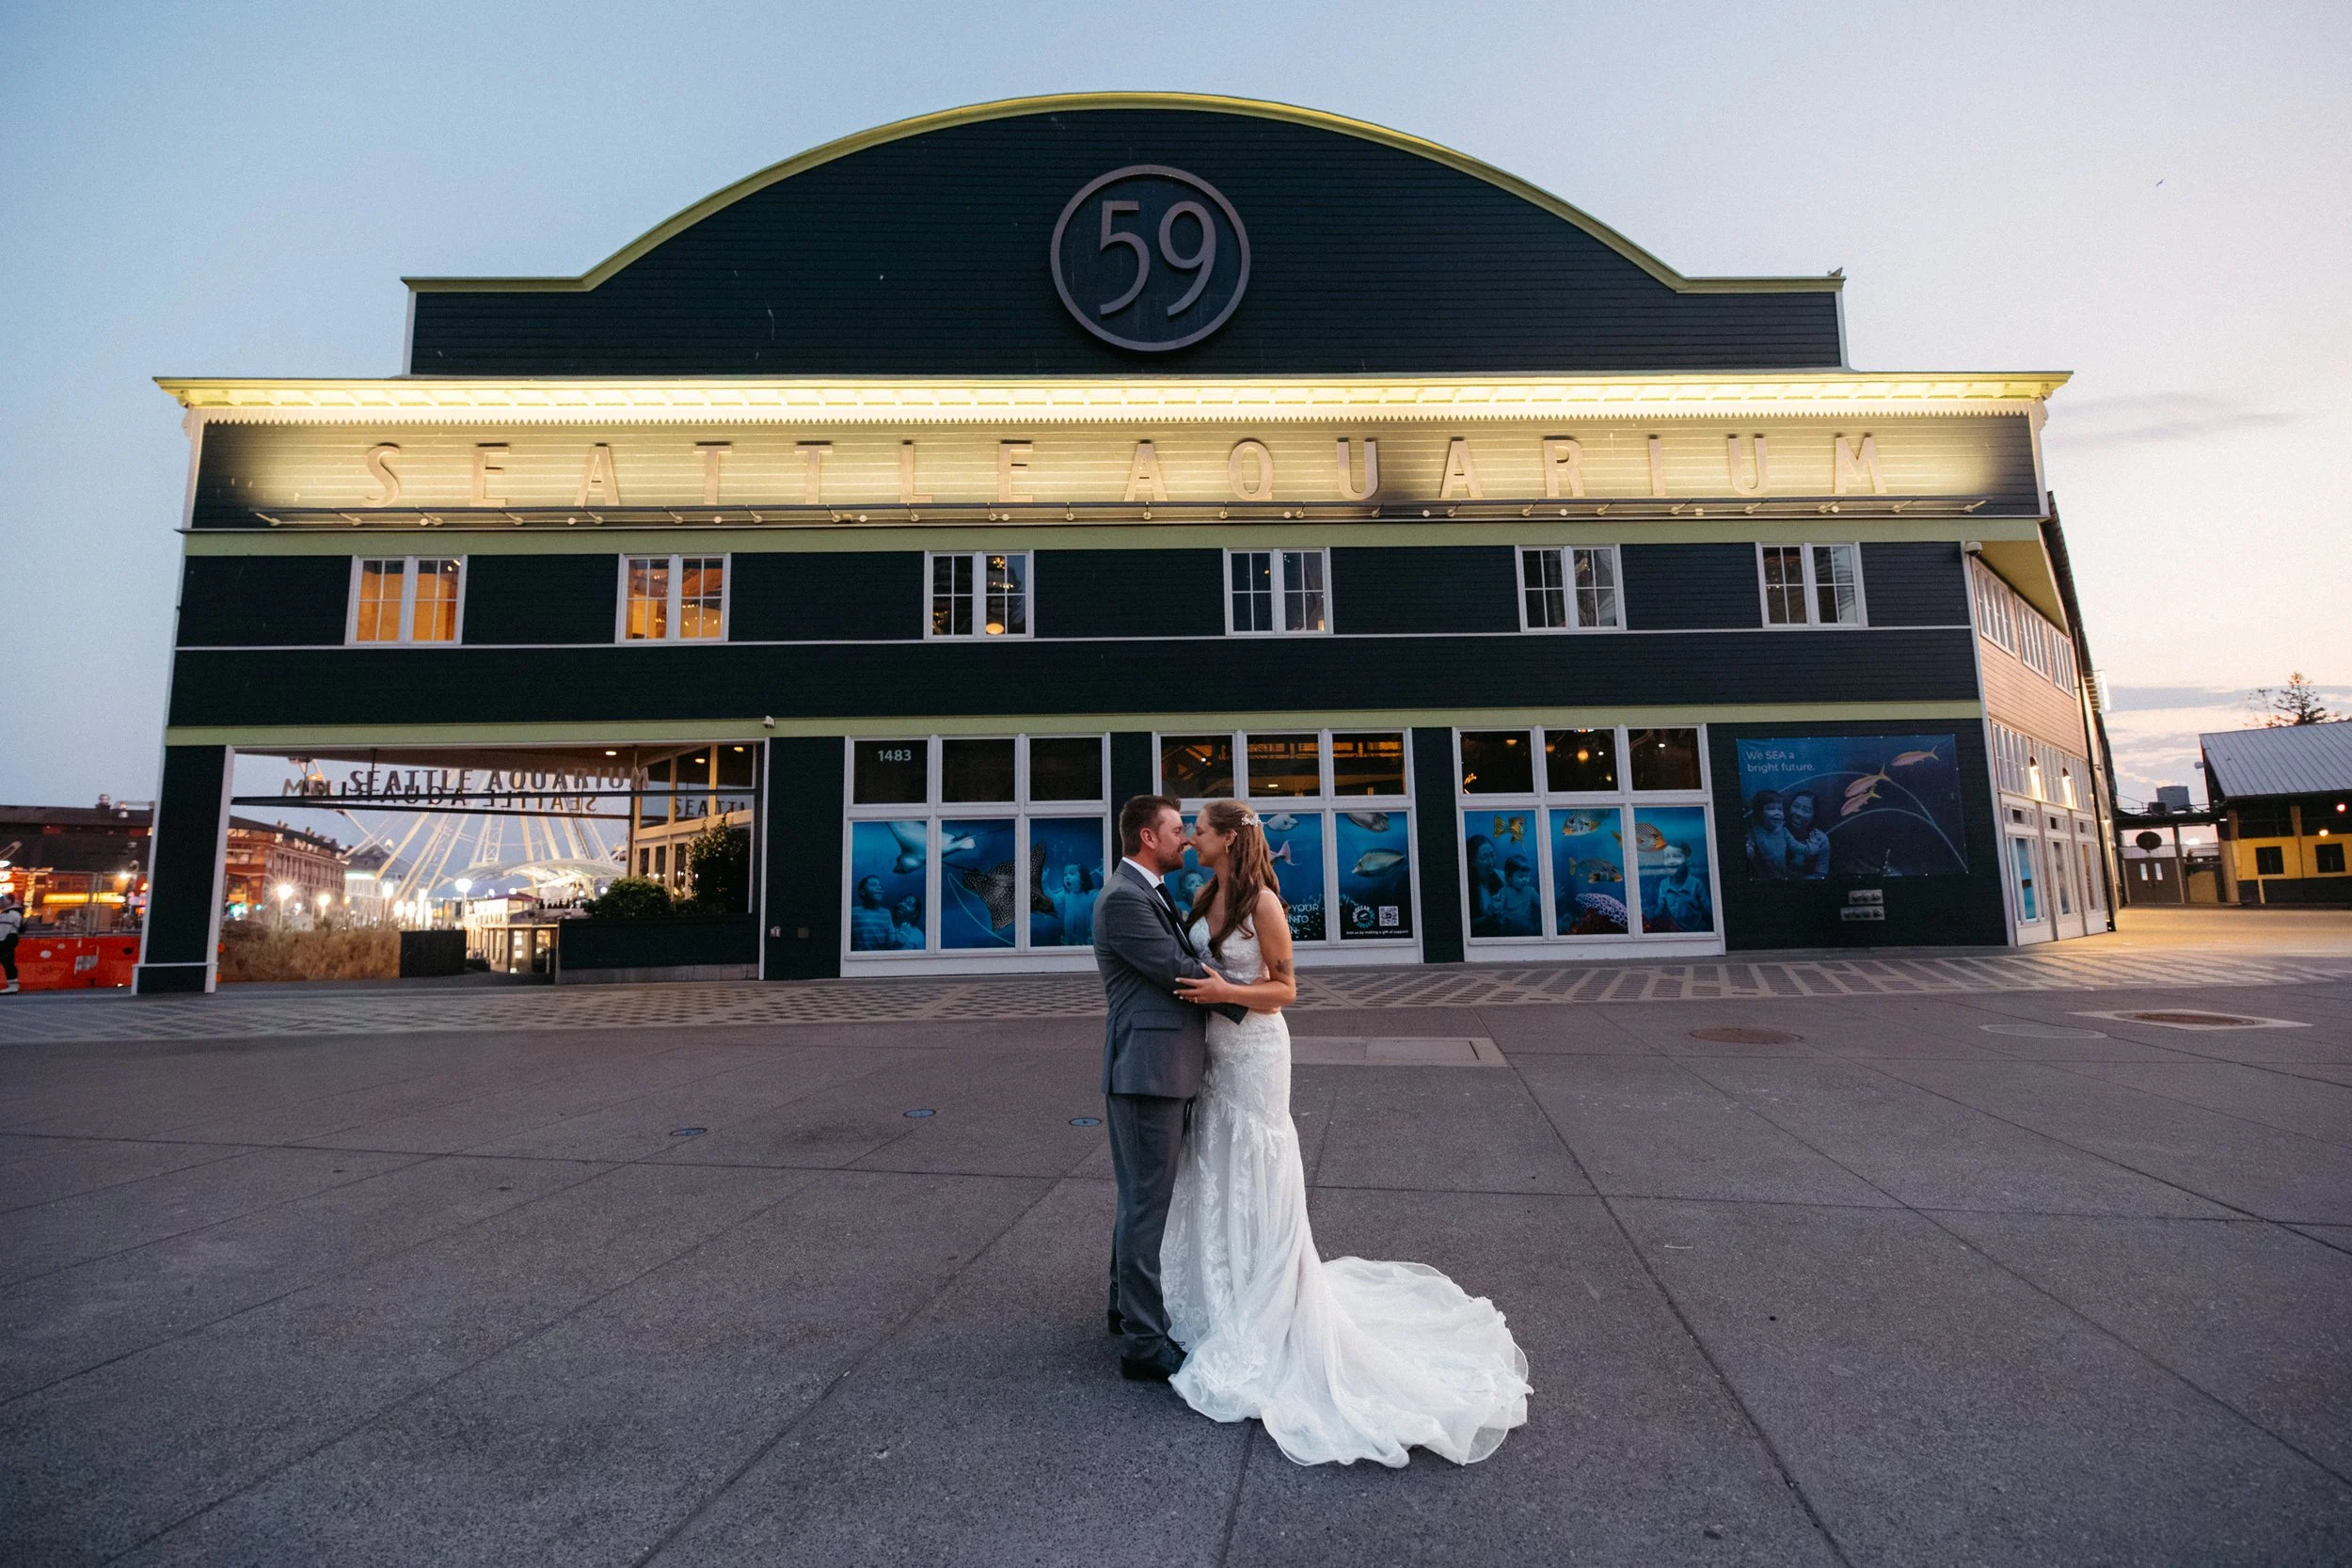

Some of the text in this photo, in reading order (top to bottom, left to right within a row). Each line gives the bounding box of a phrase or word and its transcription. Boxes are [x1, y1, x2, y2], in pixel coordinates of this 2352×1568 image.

[1099, 199, 1216, 317] 59
[361, 436, 1887, 508] SEATTLE AQUARIUM
[877, 749, 912, 762] 1483
[1745, 751, 1763, 760] We
[1766, 751, 1787, 760] SEA
[1747, 762, 1816, 774] bright future.
[348, 766, 650, 792] SEATTLE AQUARIUM
[1292, 903, 1319, 912] YOUR
